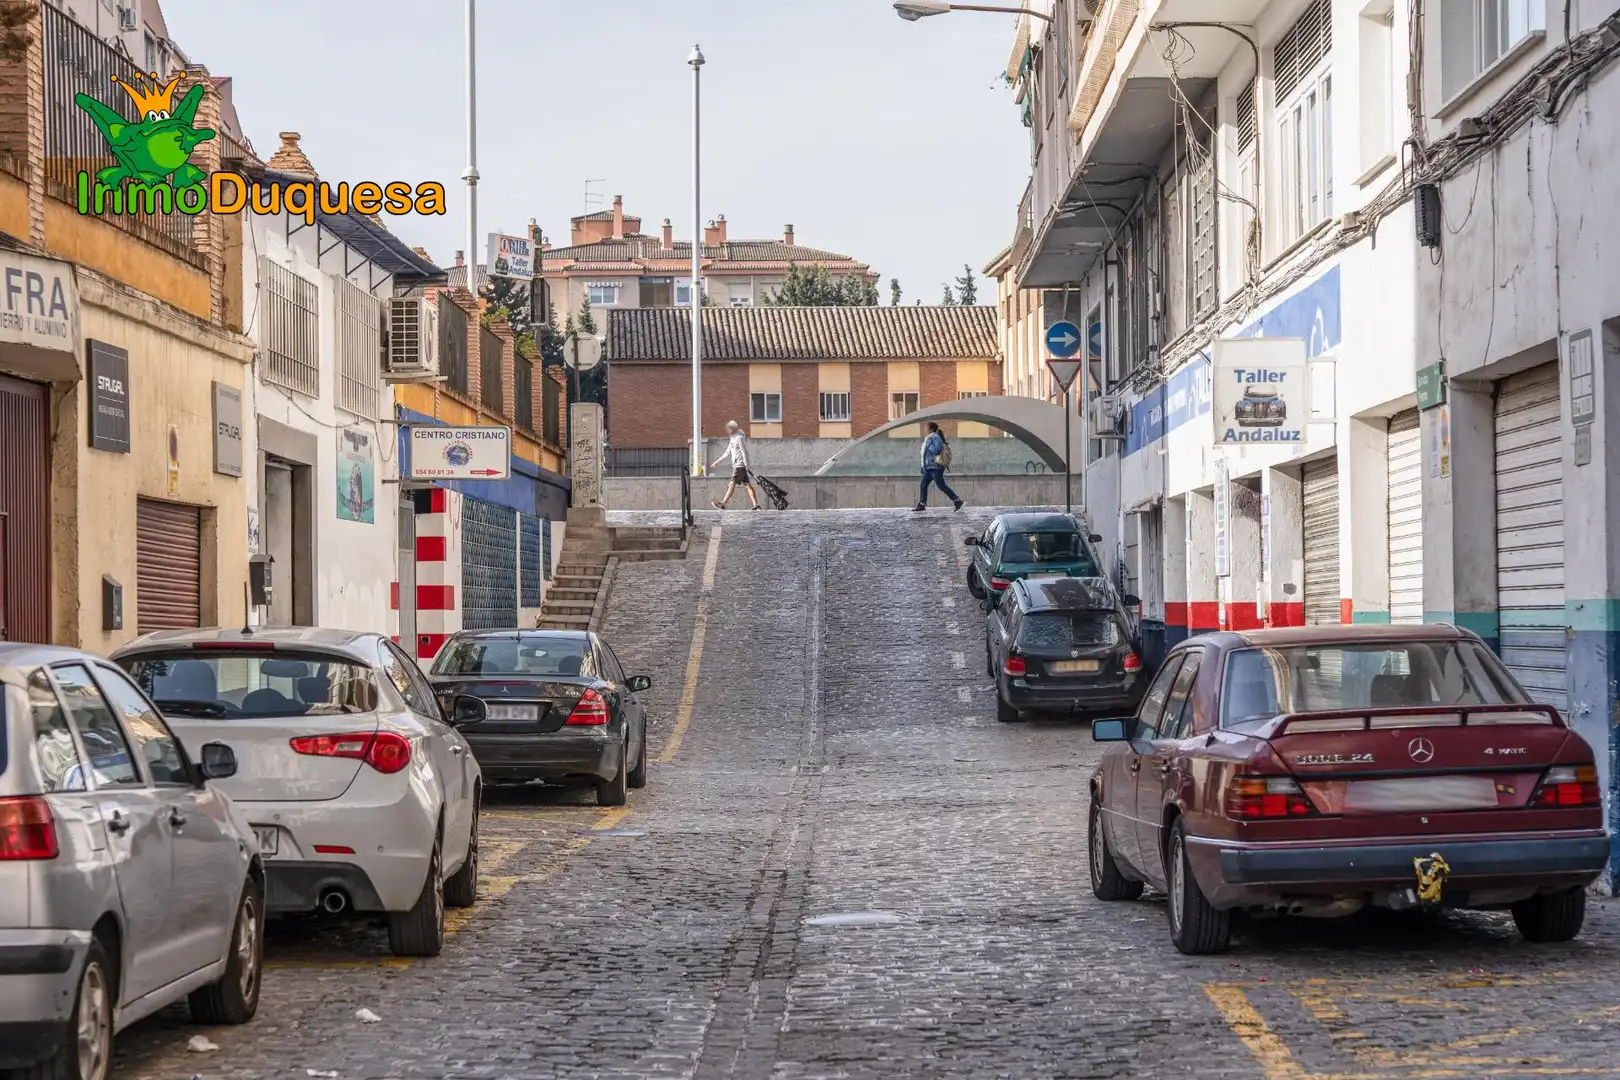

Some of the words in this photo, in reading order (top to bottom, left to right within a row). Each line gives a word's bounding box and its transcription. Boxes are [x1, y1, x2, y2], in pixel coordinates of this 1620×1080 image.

[512, 256, 529, 267] Taller
[509, 265, 533, 277] Andaluz
[34, 318, 67, 339] ALUMINIO
[1233, 369, 1287, 384] Taller
[97, 375, 125, 396] STRUGAL
[219, 421, 242, 441] STRUGAL
[414, 430, 453, 440] CENTRO
[455, 431, 506, 440] CRISTIANO
[1222, 427, 1301, 442] Andaluz
